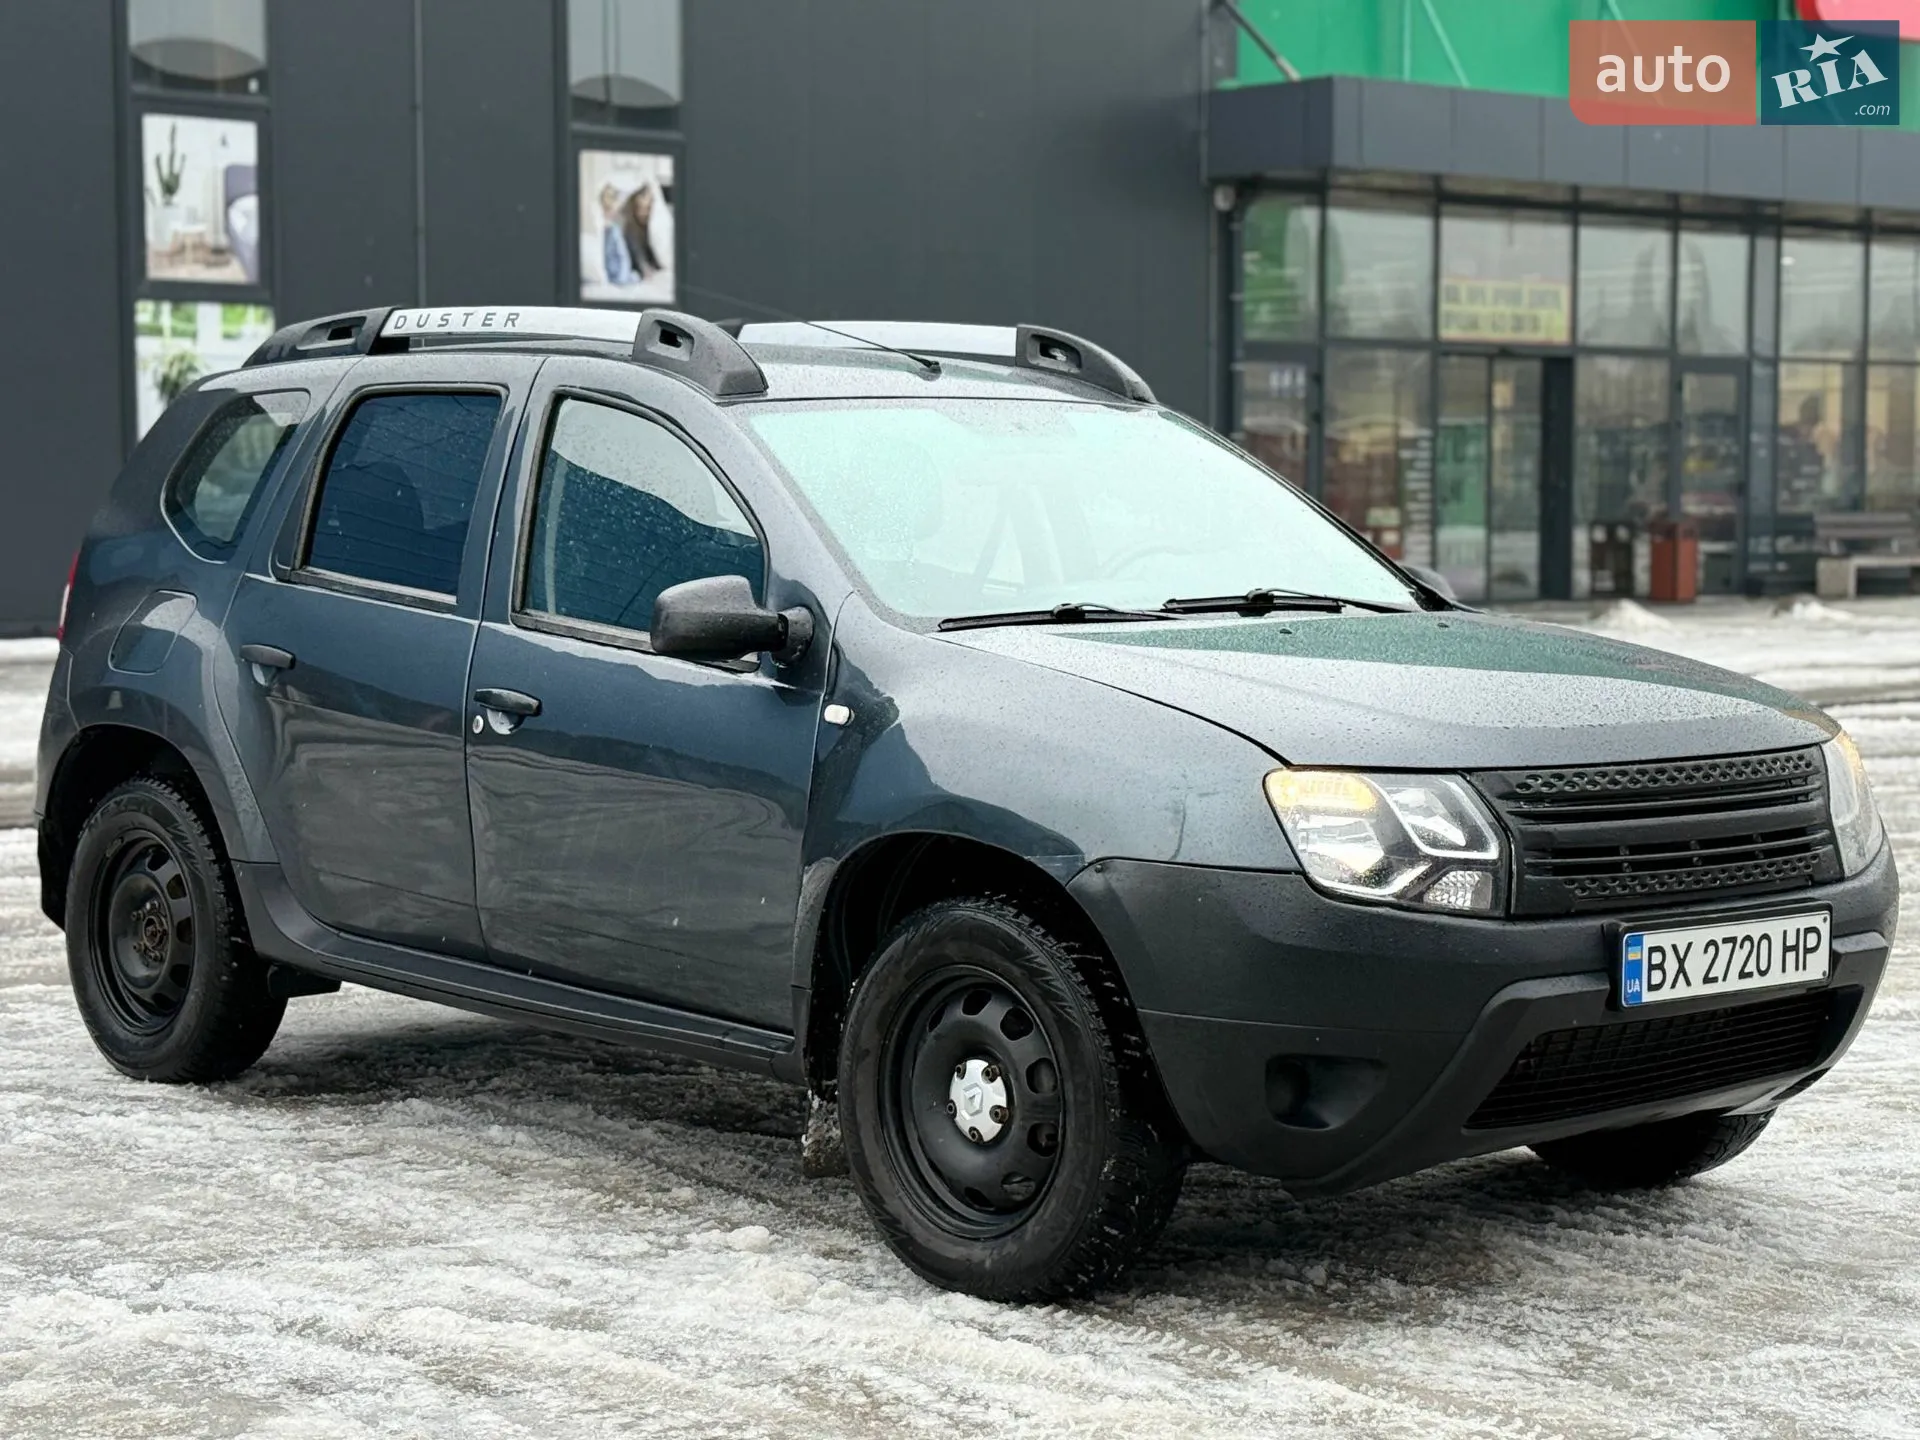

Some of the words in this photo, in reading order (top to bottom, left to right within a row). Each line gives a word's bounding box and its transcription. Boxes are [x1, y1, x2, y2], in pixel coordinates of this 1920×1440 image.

[394, 312, 520, 330] DUSTER
[1647, 942, 1693, 993] BX
[1702, 933, 1772, 985] 2720
[1781, 926, 1822, 974] HP
[1627, 979, 1641, 993] UA
